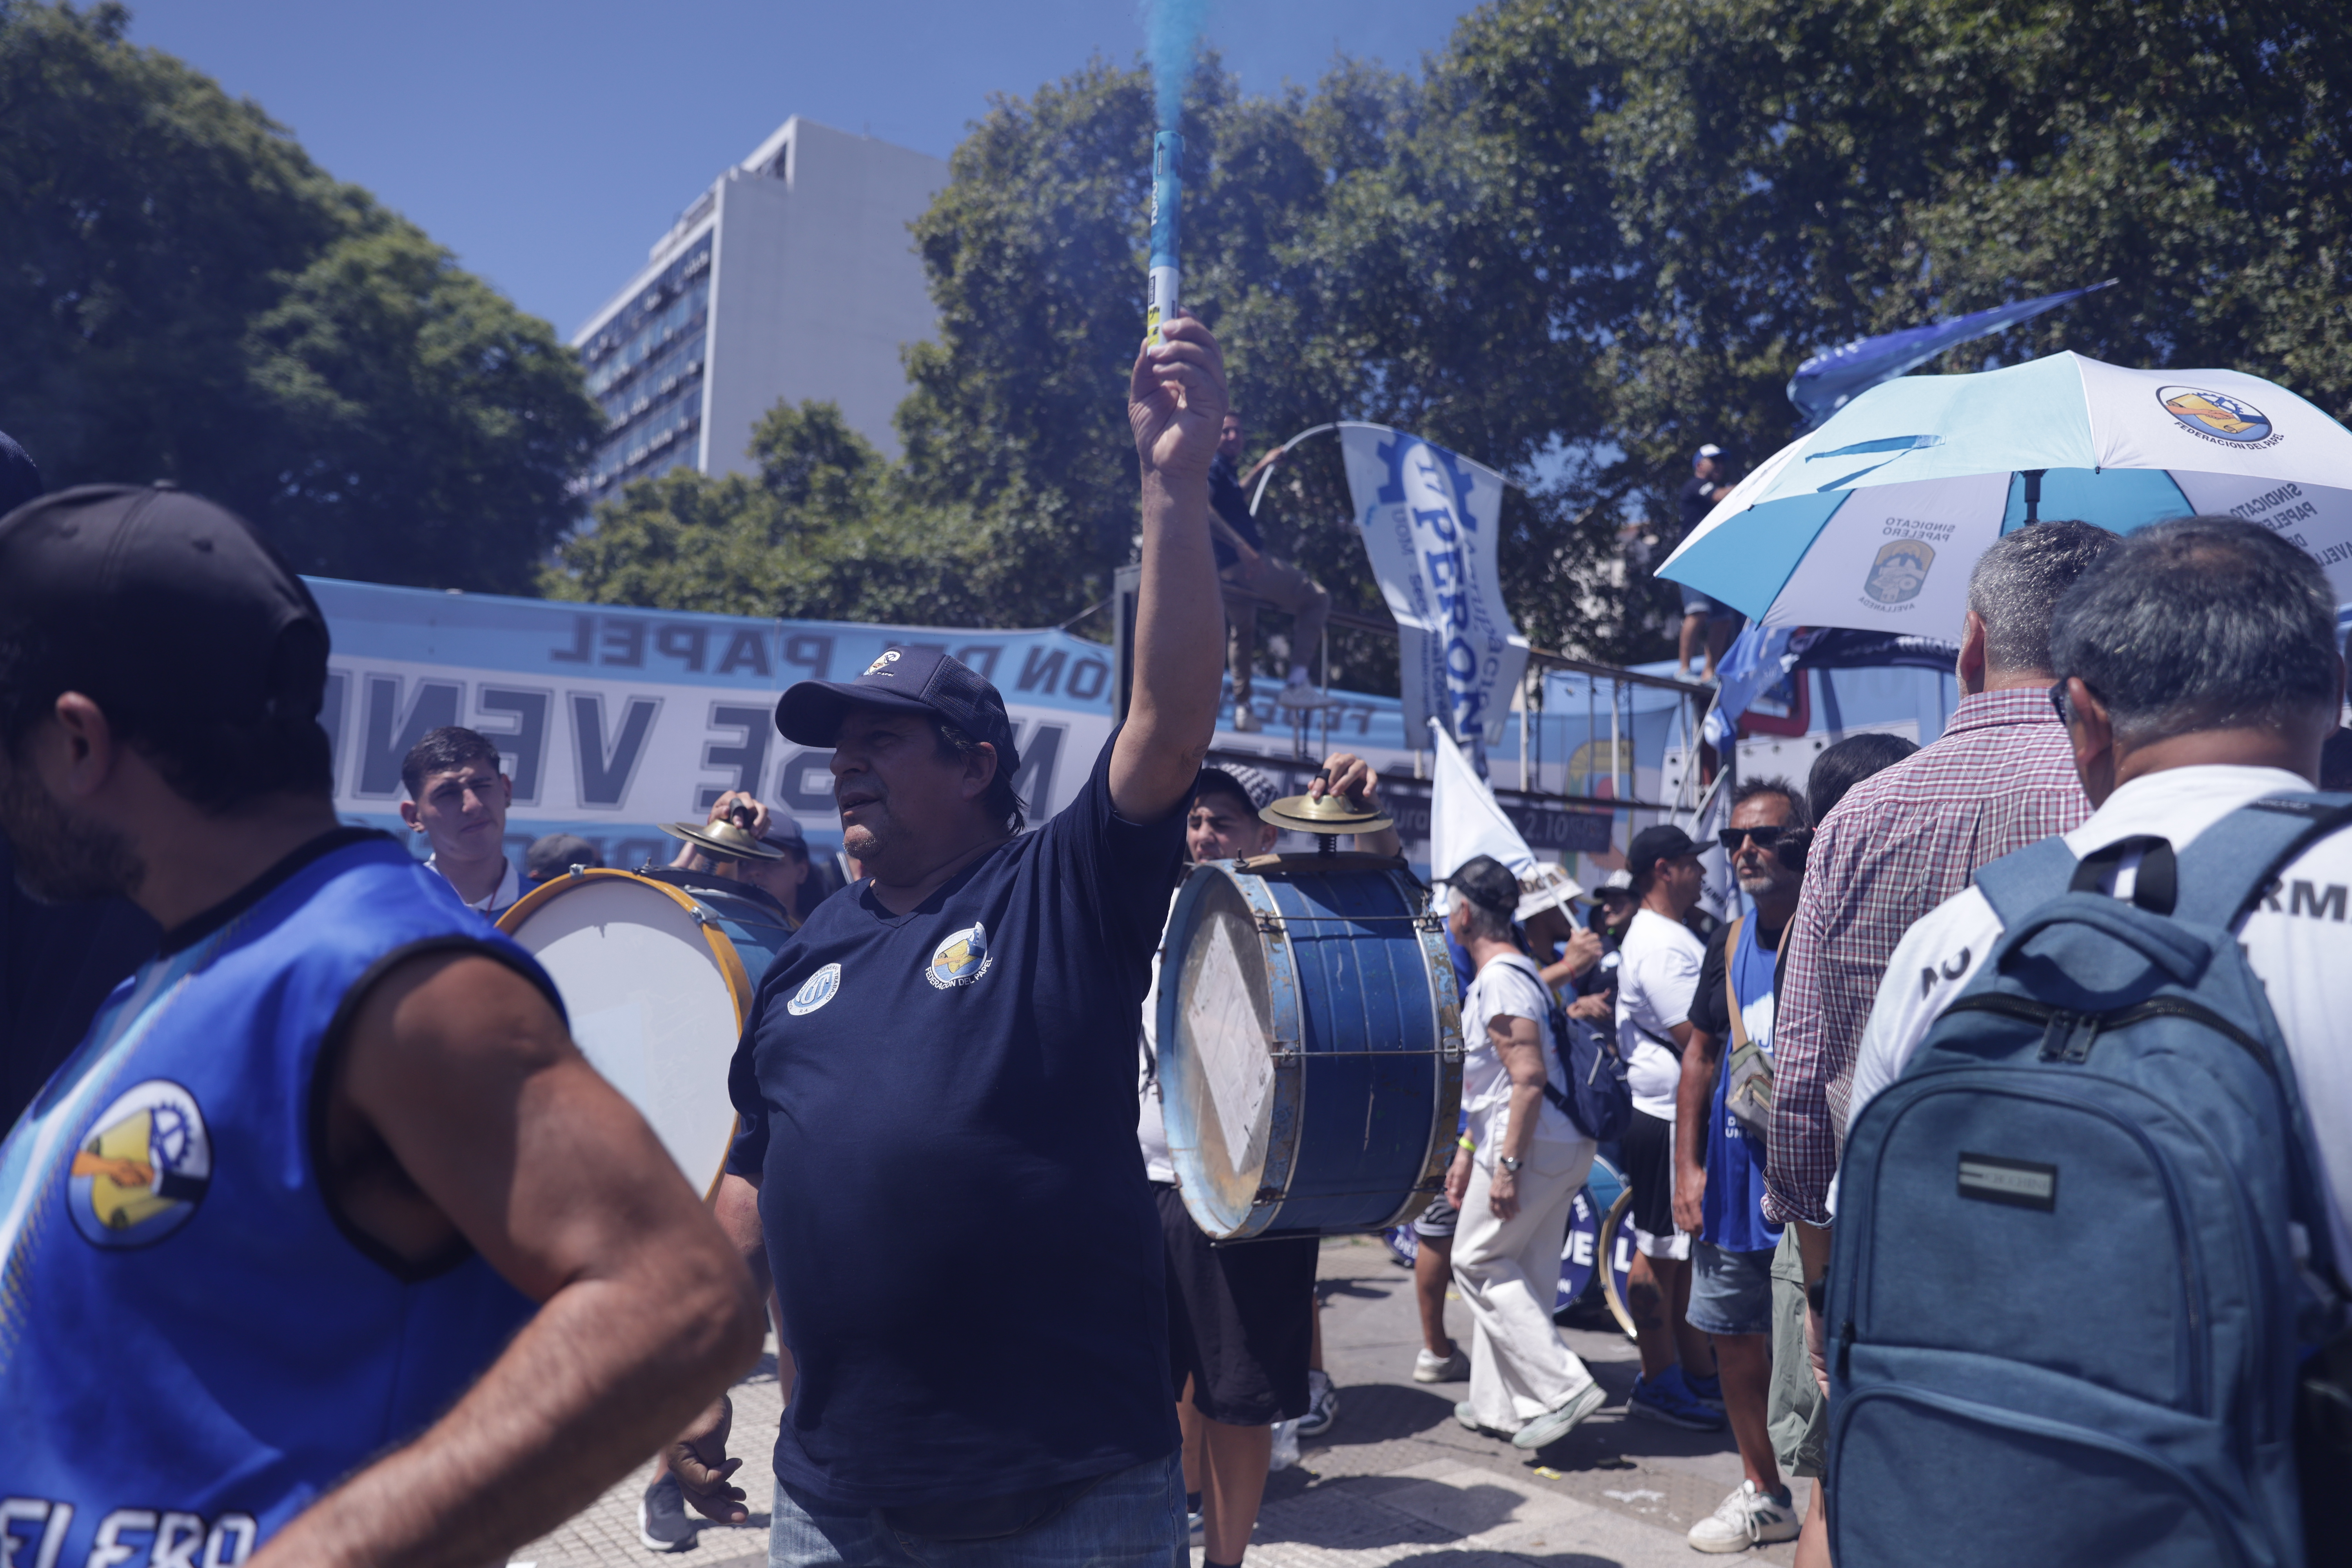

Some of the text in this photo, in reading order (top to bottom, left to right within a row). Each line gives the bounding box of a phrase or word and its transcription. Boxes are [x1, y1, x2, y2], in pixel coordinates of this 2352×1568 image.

[2174, 421, 2246, 450] FEDERACION
[2264, 433, 2285, 448] PAPEL
[1412, 506, 1483, 734] PERON
[958, 977, 975, 985] DEL
[974, 957, 993, 980] PAPEL
[826, 972, 838, 1000] TRABAJO
[0, 1497, 257, 1568] ELERO
